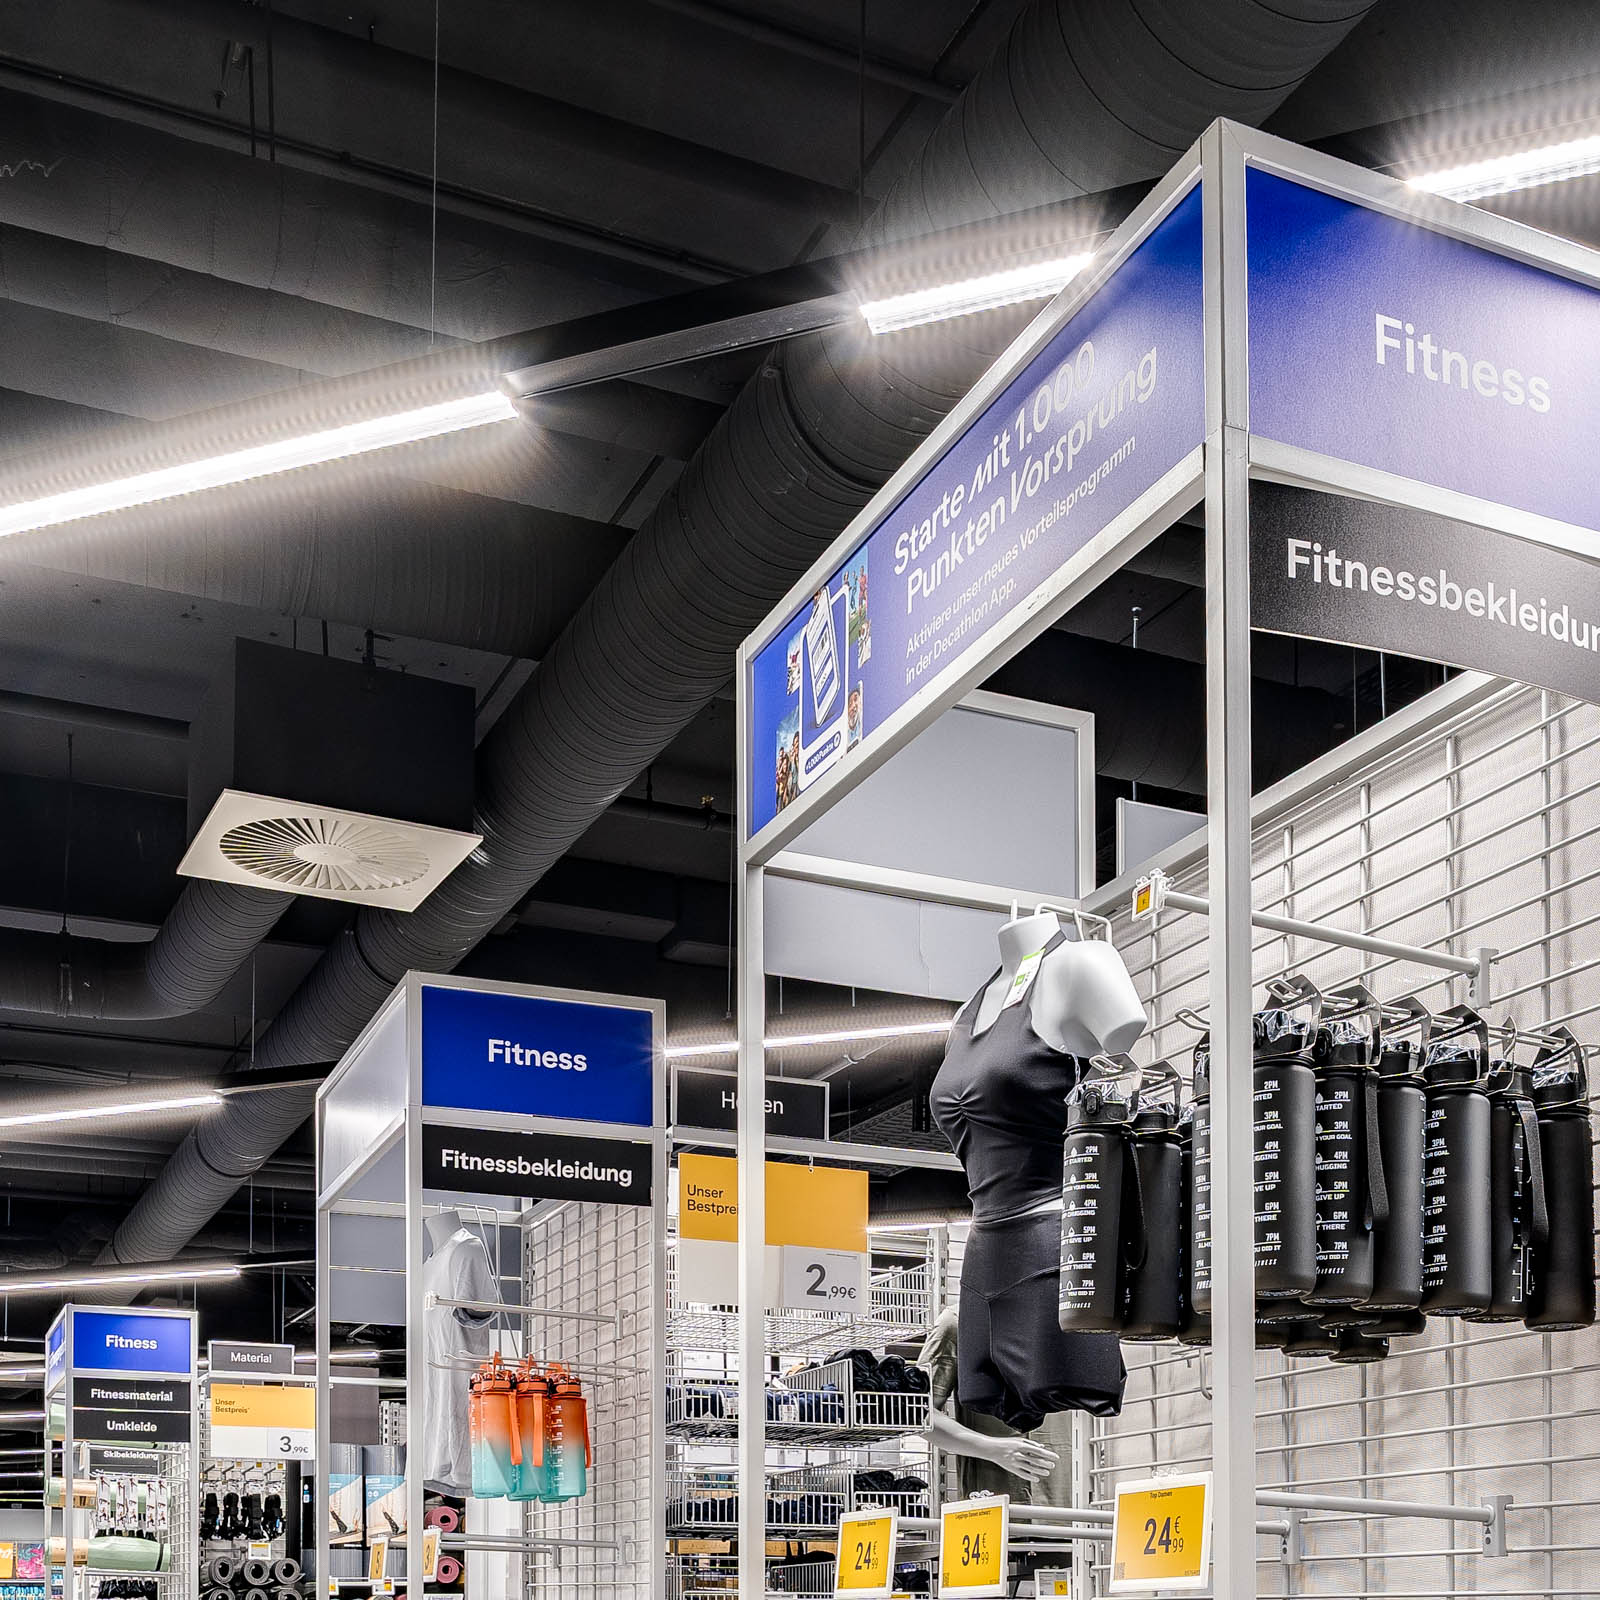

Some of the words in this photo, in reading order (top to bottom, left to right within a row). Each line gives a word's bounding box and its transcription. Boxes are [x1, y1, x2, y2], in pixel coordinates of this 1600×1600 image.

[1375, 313, 1551, 414] Fitness
[894, 483, 965, 576] Starte
[1015, 341, 1095, 451] 1.000
[906, 495, 1005, 615] Punkten
[1009, 347, 1157, 514] Vorsprung
[905, 608, 952, 659] Aktiviere
[952, 581, 984, 612] unser
[984, 547, 1018, 586] neues
[1019, 436, 1136, 553] Vorteilsprogramm
[905, 667, 915, 685] in
[915, 650, 933, 679] der
[933, 603, 990, 664] Decathlon
[990, 577, 1017, 612] App.
[488, 1038, 588, 1072] Fitness
[1264, 1080, 1278, 1089] 2PM
[1254, 1093, 1273, 1101] RTED
[1334, 1091, 1348, 1100] 2PM
[1316, 1103, 1343, 1111] TARTED
[1264, 1111, 1278, 1119] 3PM
[1432, 1109, 1444, 1118] 2PM
[1254, 1124, 1266, 1132] OUR
[1334, 1121, 1348, 1130] 3PM
[1264, 1141, 1278, 1149] 4PM
[1432, 1138, 1445, 1146] 3PM
[1334, 1151, 1348, 1159] 4PM
[441, 1149, 633, 1187] Fitnessbekleidung
[1432, 1167, 1445, 1175] 4PM
[1265, 1172, 1279, 1180] 5PM
[1334, 1182, 1348, 1190] 5PM
[687, 1184, 724, 1199] Unser
[1432, 1196, 1445, 1204] 5PM
[687, 1199, 738, 1216] Bestprei
[1265, 1202, 1279, 1210] 6PM
[1333, 1211, 1348, 1220] 6PM
[1432, 1225, 1446, 1233] 6PM
[1265, 1233, 1280, 1241] 7PM
[1334, 1242, 1348, 1250] 7PM
[1433, 1254, 1446, 1262] 7PM
[805, 1263, 856, 1300] 2,99€
[105, 1335, 158, 1350] Fitness
[230, 1352, 272, 1363] Material
[90, 1388, 173, 1402] Fitnessmaterial
[106, 1420, 158, 1432] Umkleide
[280, 1436, 308, 1453] 3,99€
[103, 1451, 159, 1461] Skibekleidung
[1144, 1516, 1172, 1555] 24
[962, 1533, 980, 1567] 34
[855, 1541, 872, 1571] 24
